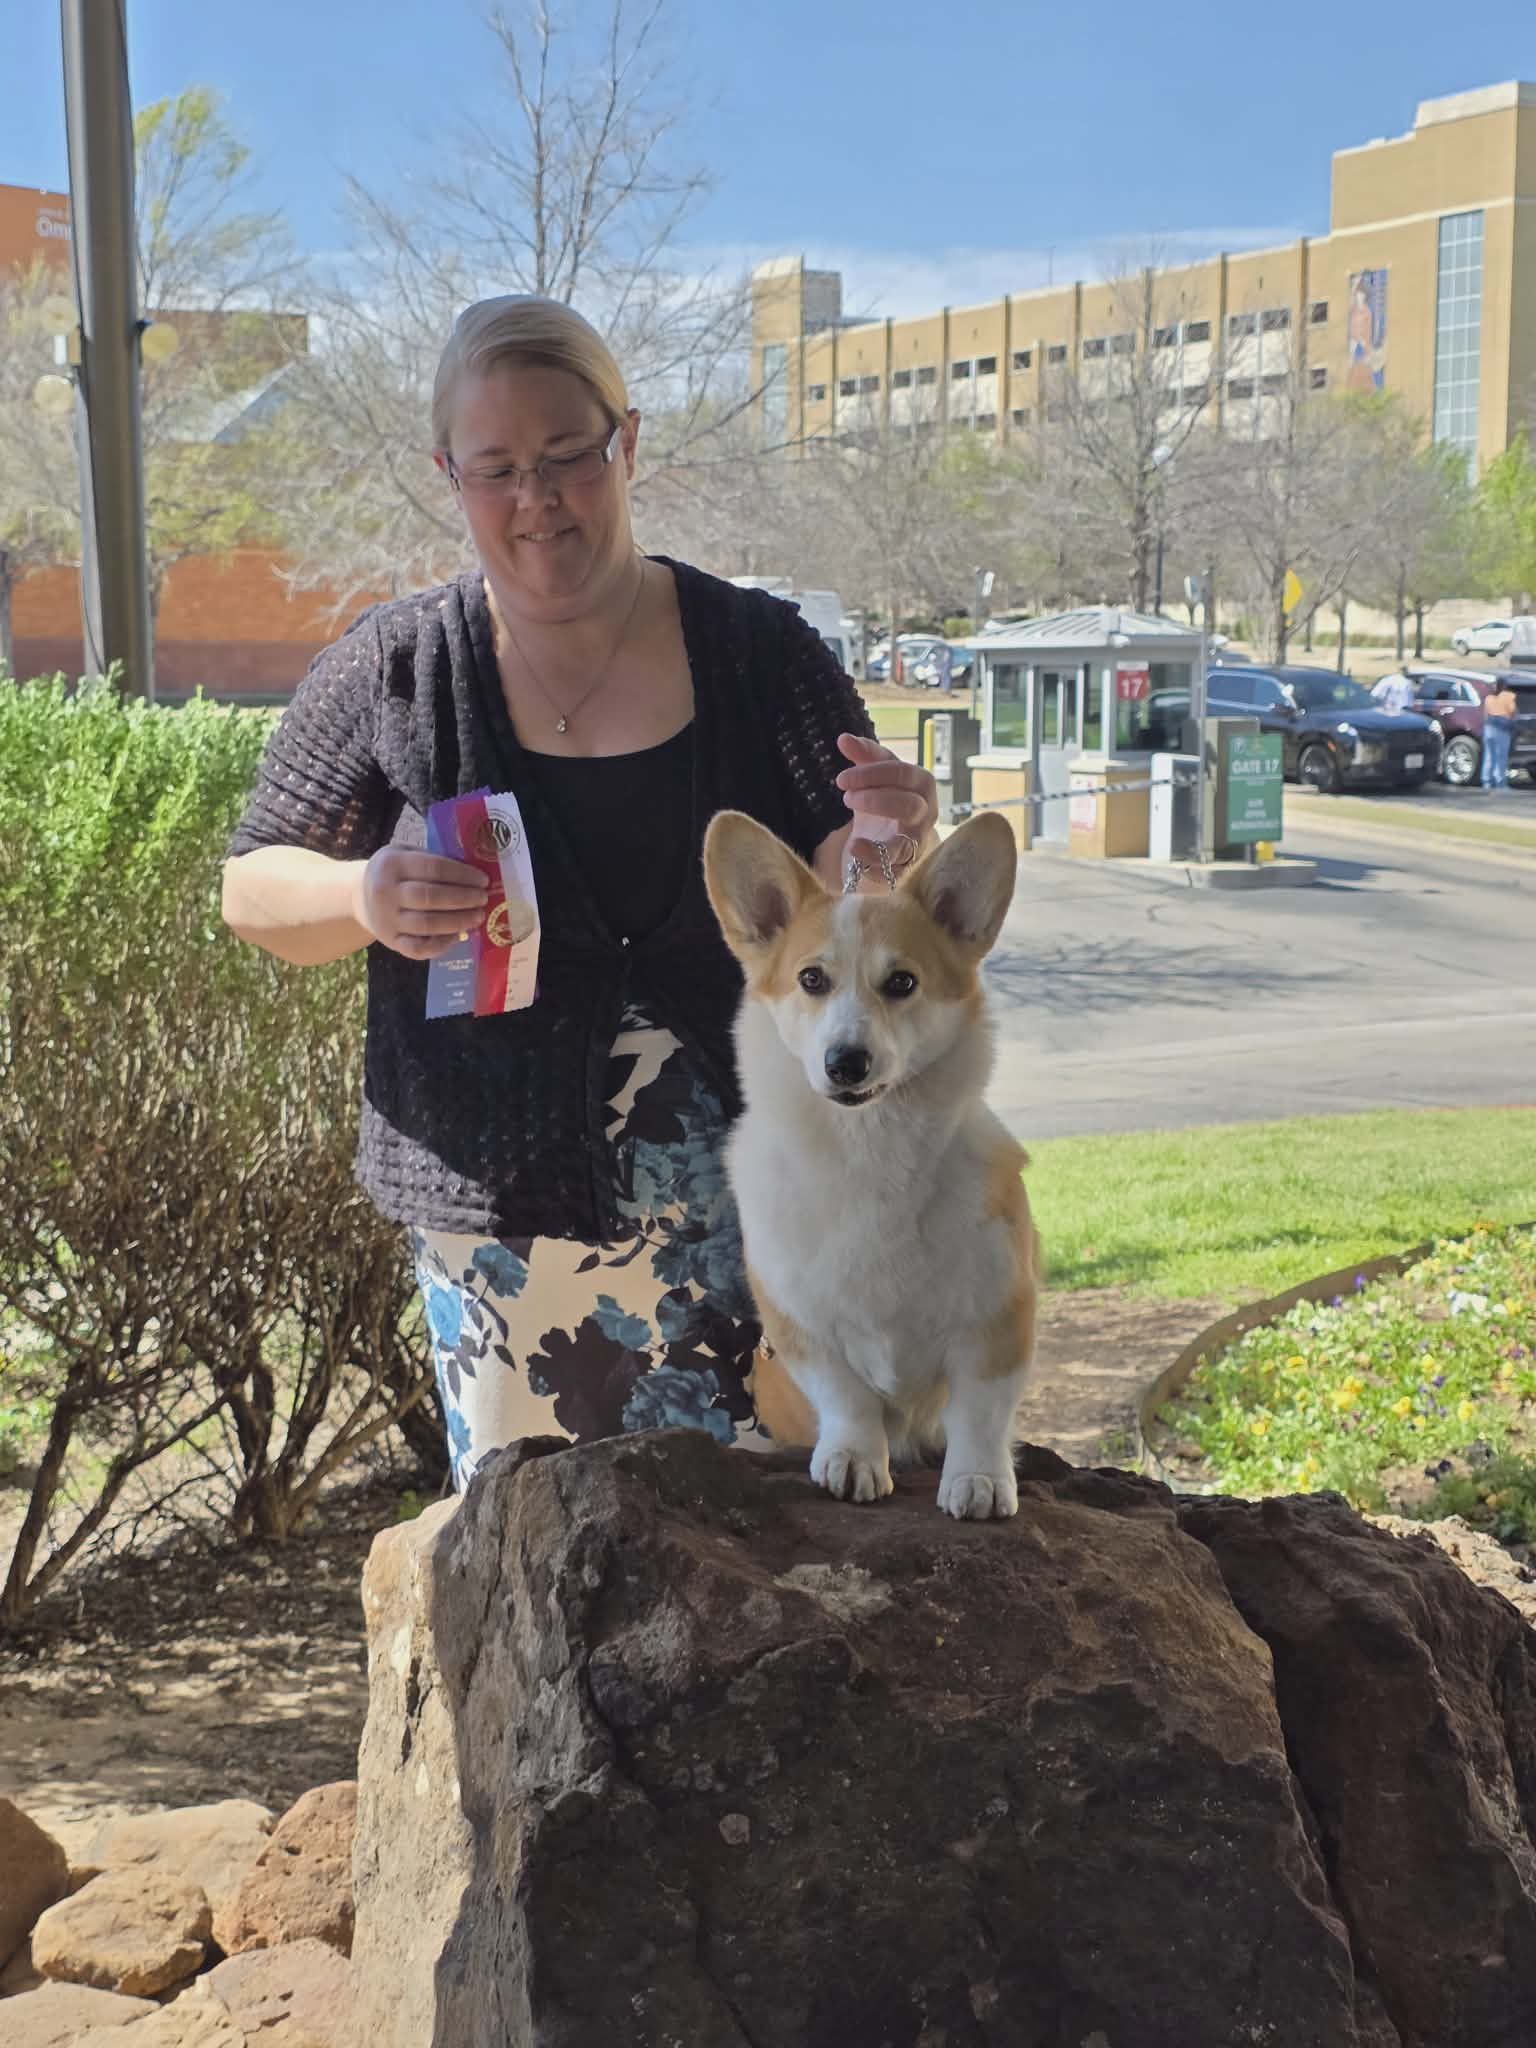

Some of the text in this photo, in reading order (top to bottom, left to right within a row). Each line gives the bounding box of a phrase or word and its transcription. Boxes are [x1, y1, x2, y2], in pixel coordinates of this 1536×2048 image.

[1121, 678, 1143, 697] 17
[1232, 759, 1280, 774] GATE 17
